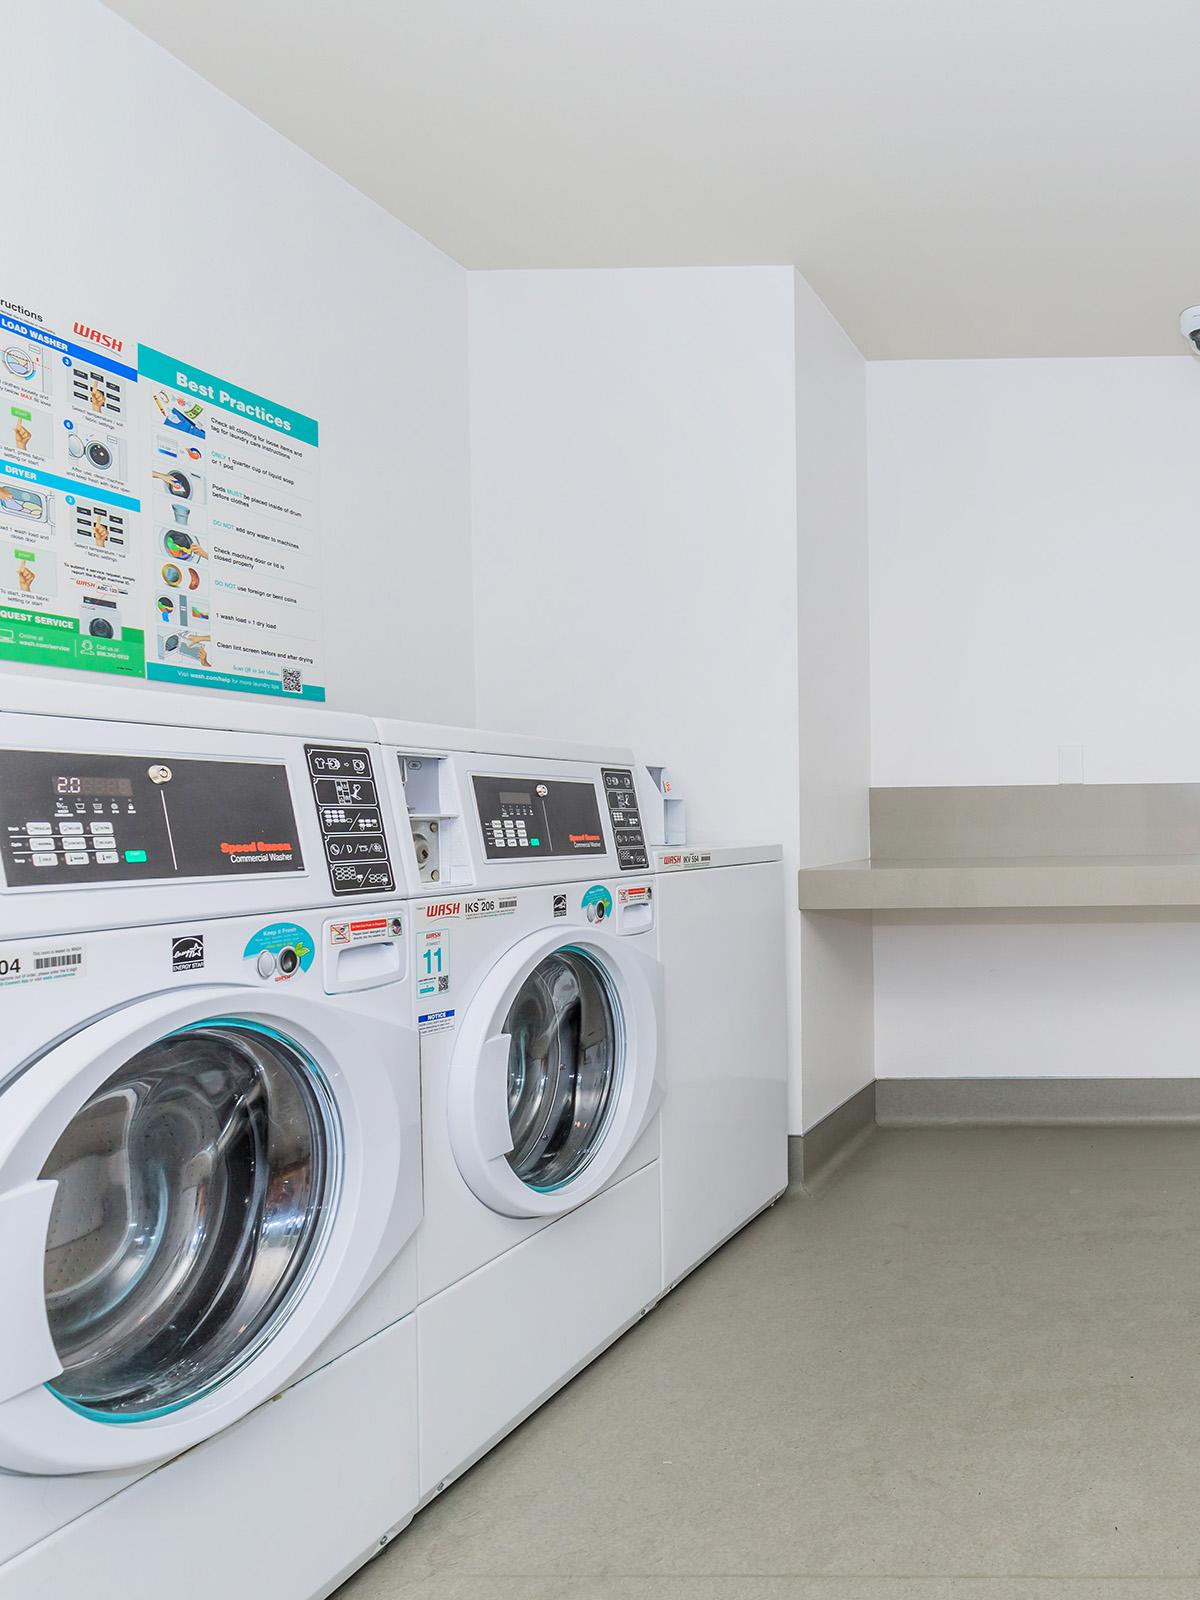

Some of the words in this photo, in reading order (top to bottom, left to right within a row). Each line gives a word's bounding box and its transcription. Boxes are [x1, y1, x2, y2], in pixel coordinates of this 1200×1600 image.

[1, 318, 28, 335] LOAD
[29, 329, 69, 352] WASHER
[73, 321, 123, 352] WASH
[176, 371, 215, 399] Best
[219, 390, 292, 431] Practices
[211, 417, 227, 428] Check
[236, 426, 257, 441] clothing
[266, 438, 279, 448] loose
[294, 450, 303, 458] and
[211, 425, 220, 434] tag
[229, 431, 249, 445] laundry
[250, 439, 261, 448] care
[262, 443, 291, 460] instructions
[5, 464, 37, 481] DRYER
[223, 463, 234, 471] pod
[232, 459, 251, 469] quarter
[268, 471, 282, 481] liquid
[283, 477, 294, 486] soap
[212, 491, 230, 502] before
[230, 497, 250, 508] clothes
[212, 483, 226, 493] Pods
[251, 497, 268, 508] placed
[269, 501, 283, 511] inside
[289, 509, 302, 518] drum
[212, 519, 222, 527] DO
[223, 522, 235, 531] NOT
[235, 526, 246, 534] add
[246, 529, 256, 538] any
[257, 532, 270, 541] water
[277, 539, 300, 550] machines
[213, 546, 231, 555] Check
[231, 550, 253, 561] machine
[254, 555, 266, 565] door
[213, 554, 232, 563] closed
[232, 559, 254, 570] properly
[75, 579, 96, 589] WASH
[224, 581, 236, 589] NOT
[247, 587, 266, 597] foreign
[272, 593, 283, 601] bent
[0, 610, 32, 622] QUEST
[34, 615, 74, 630] SERVICE
[235, 616, 247, 624] load
[256, 621, 265, 629] dry
[216, 641, 232, 650] Clean
[242, 646, 260, 655] screen
[260, 648, 277, 658] before
[277, 651, 286, 659] and
[287, 653, 298, 661] after
[298, 656, 314, 665] drying
[177, 670, 190, 678] Visit
[190, 672, 232, 684] wash.com/help
[57, 776, 81, 793] 2.0
[220, 841, 257, 855] Speed
[230, 853, 269, 863] Commercial
[269, 853, 293, 861] Washer
[663, 855, 682, 865] WASH
[426, 902, 461, 917] WASH
[464, 902, 479, 914] IKS
[481, 900, 495, 911] 206
[173, 962, 192, 972] ENERGY
[192, 960, 204, 970] STAR
[423, 947, 442, 975] 11
[427, 1011, 446, 1021] NOTICE
